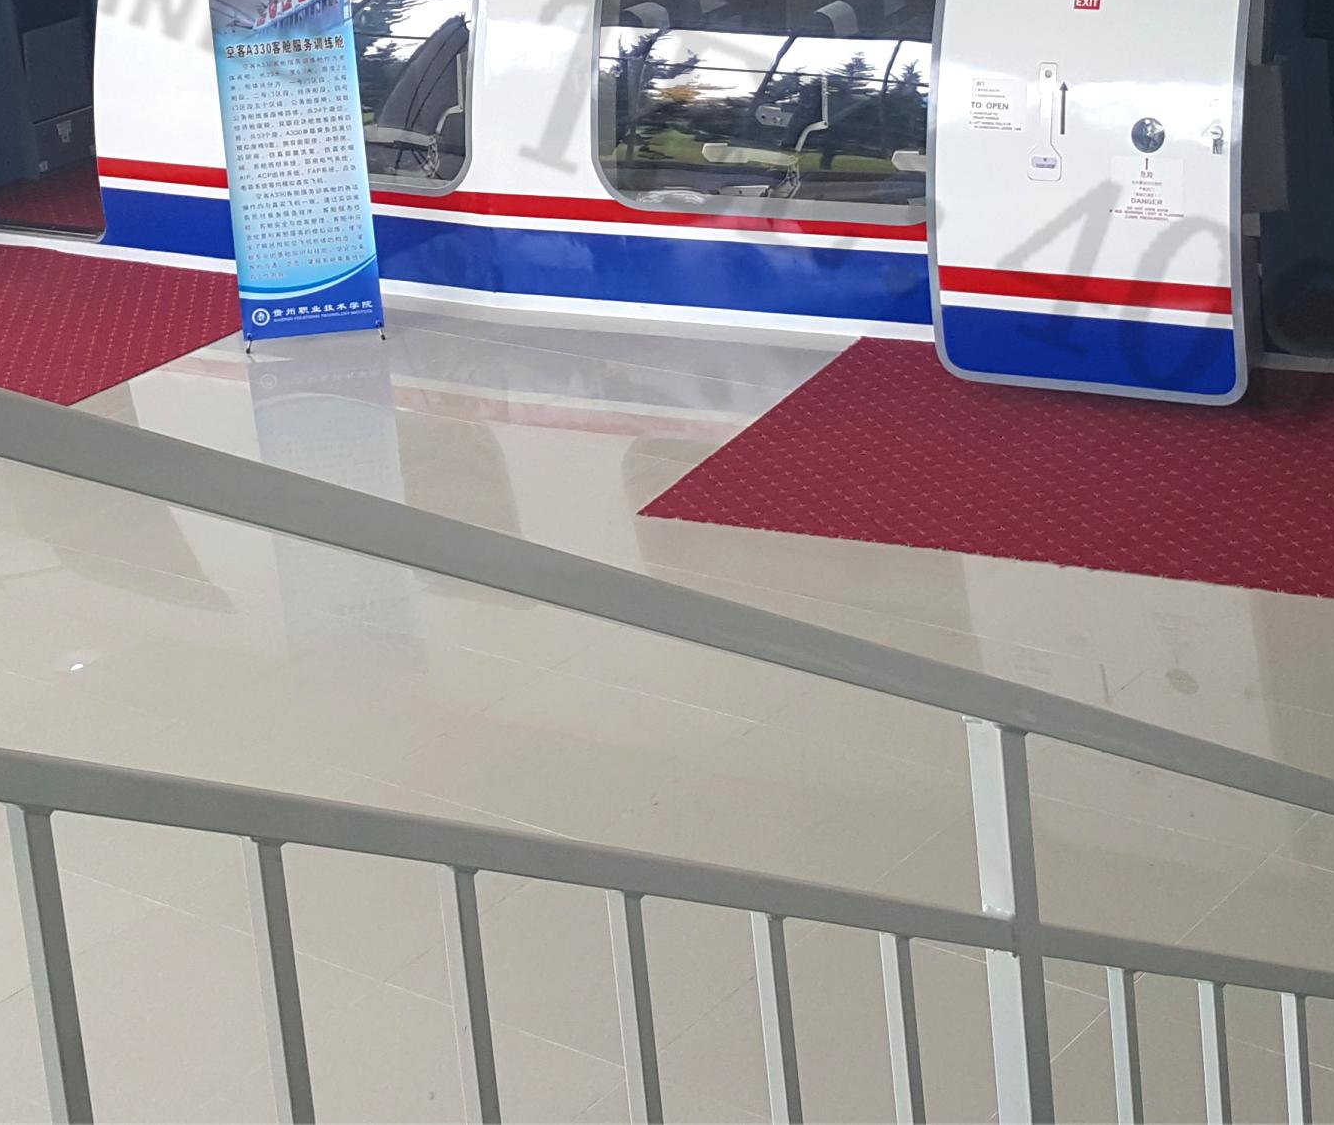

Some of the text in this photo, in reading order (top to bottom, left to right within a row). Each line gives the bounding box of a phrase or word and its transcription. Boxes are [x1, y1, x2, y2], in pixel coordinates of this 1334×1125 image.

[225, 36, 345, 59] 空客A330客舱服务训练舱
[971, 101, 1009, 110] TO OPEN
[1130, 197, 1163, 205] DANGER
